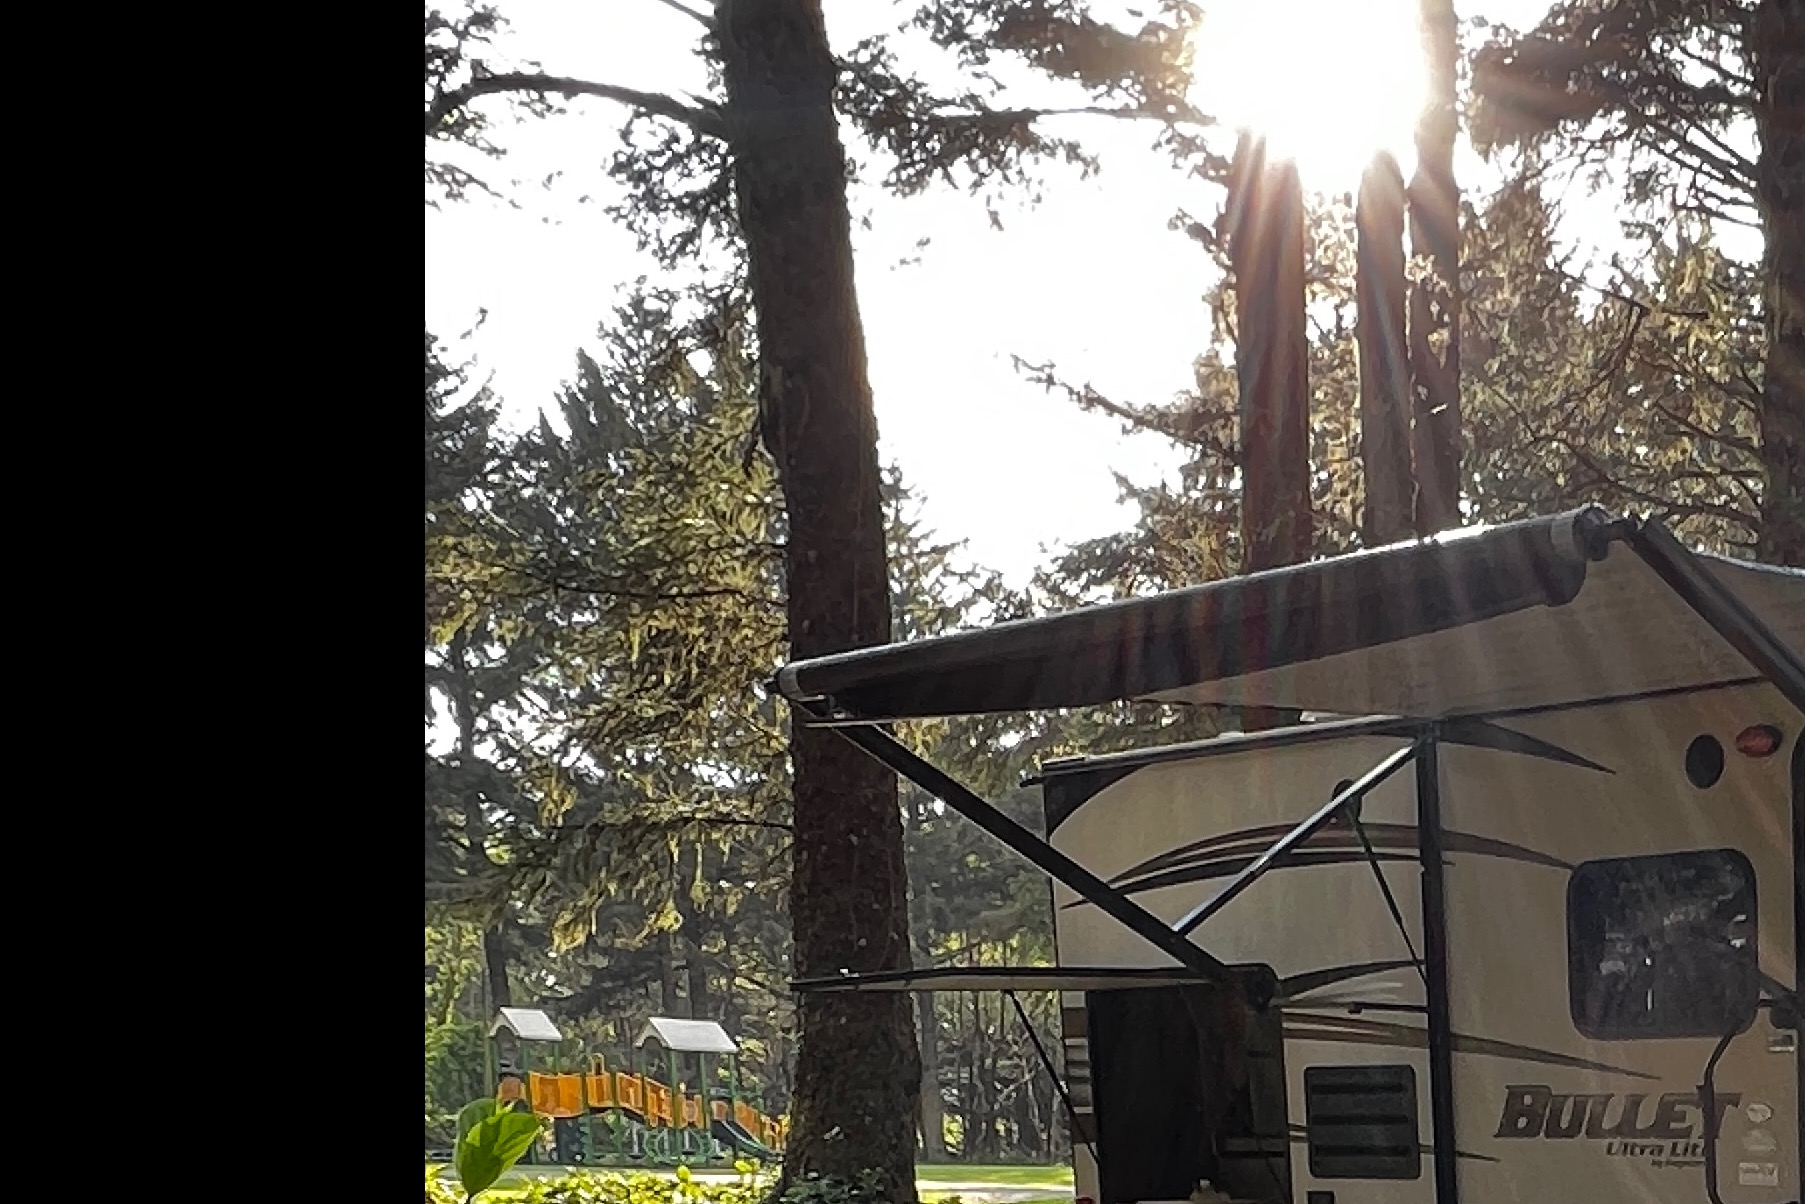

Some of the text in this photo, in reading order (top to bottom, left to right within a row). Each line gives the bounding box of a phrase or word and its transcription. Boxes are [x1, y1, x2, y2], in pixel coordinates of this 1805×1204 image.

[1493, 1084, 1743, 1139] BULLET
[1606, 1142, 1705, 1158] Ultra Lit
